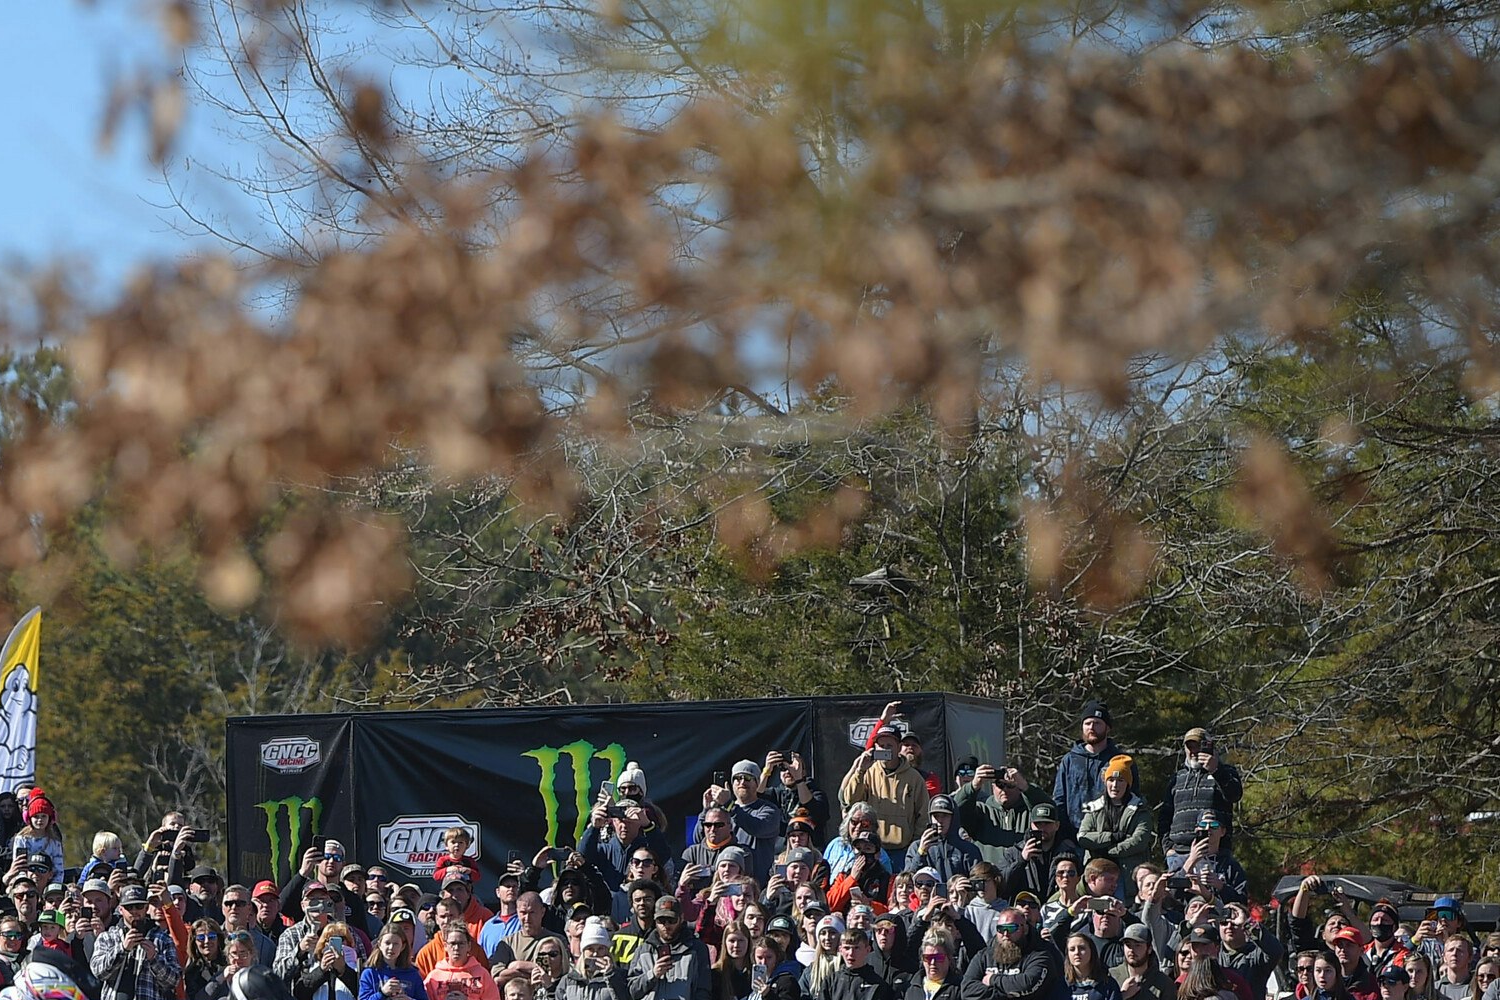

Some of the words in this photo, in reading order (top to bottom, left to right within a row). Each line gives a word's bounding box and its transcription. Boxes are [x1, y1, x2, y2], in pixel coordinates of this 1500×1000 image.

[264, 745, 317, 760] GNCC
[277, 758, 306, 766] RACING
[384, 827, 460, 854] GNC
[408, 852, 452, 864] RACIN
